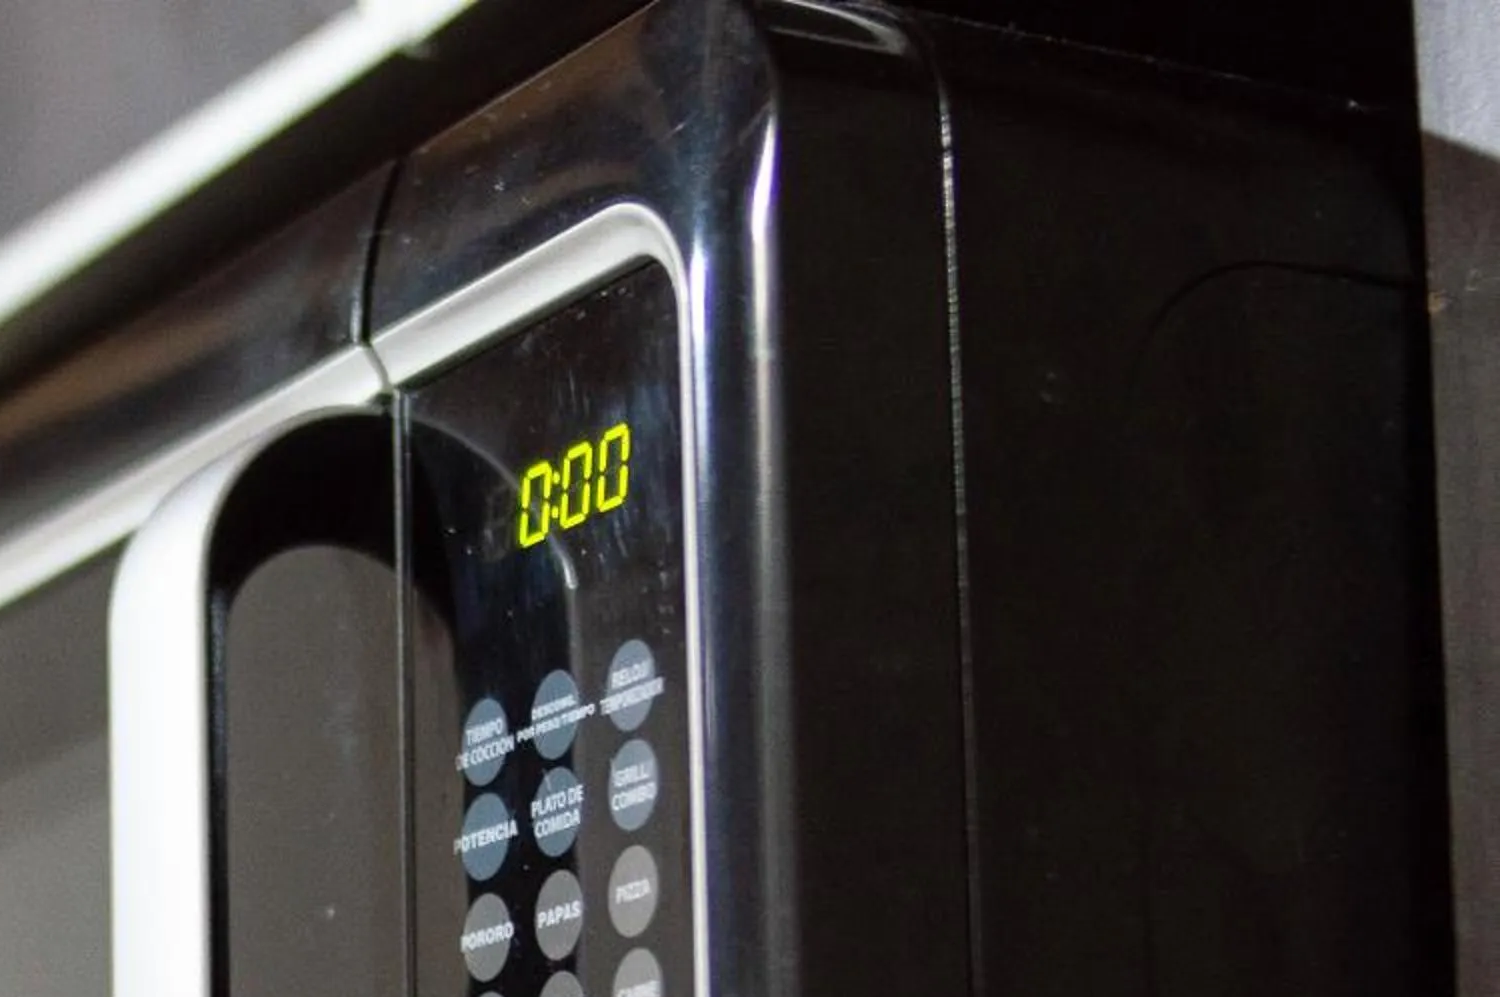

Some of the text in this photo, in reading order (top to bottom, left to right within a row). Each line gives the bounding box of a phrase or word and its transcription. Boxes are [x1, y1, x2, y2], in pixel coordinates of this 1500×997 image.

[519, 421, 630, 548] 0:00
[466, 718, 503, 746] TIEMPO
[455, 735, 514, 771] DE COCCION
[531, 784, 584, 818] PLATO DE
[453, 819, 519, 855] POTENCIA
[534, 809, 581, 838] COMIDA
[537, 900, 581, 929] PAPAS
[460, 921, 514, 953] PORORO
